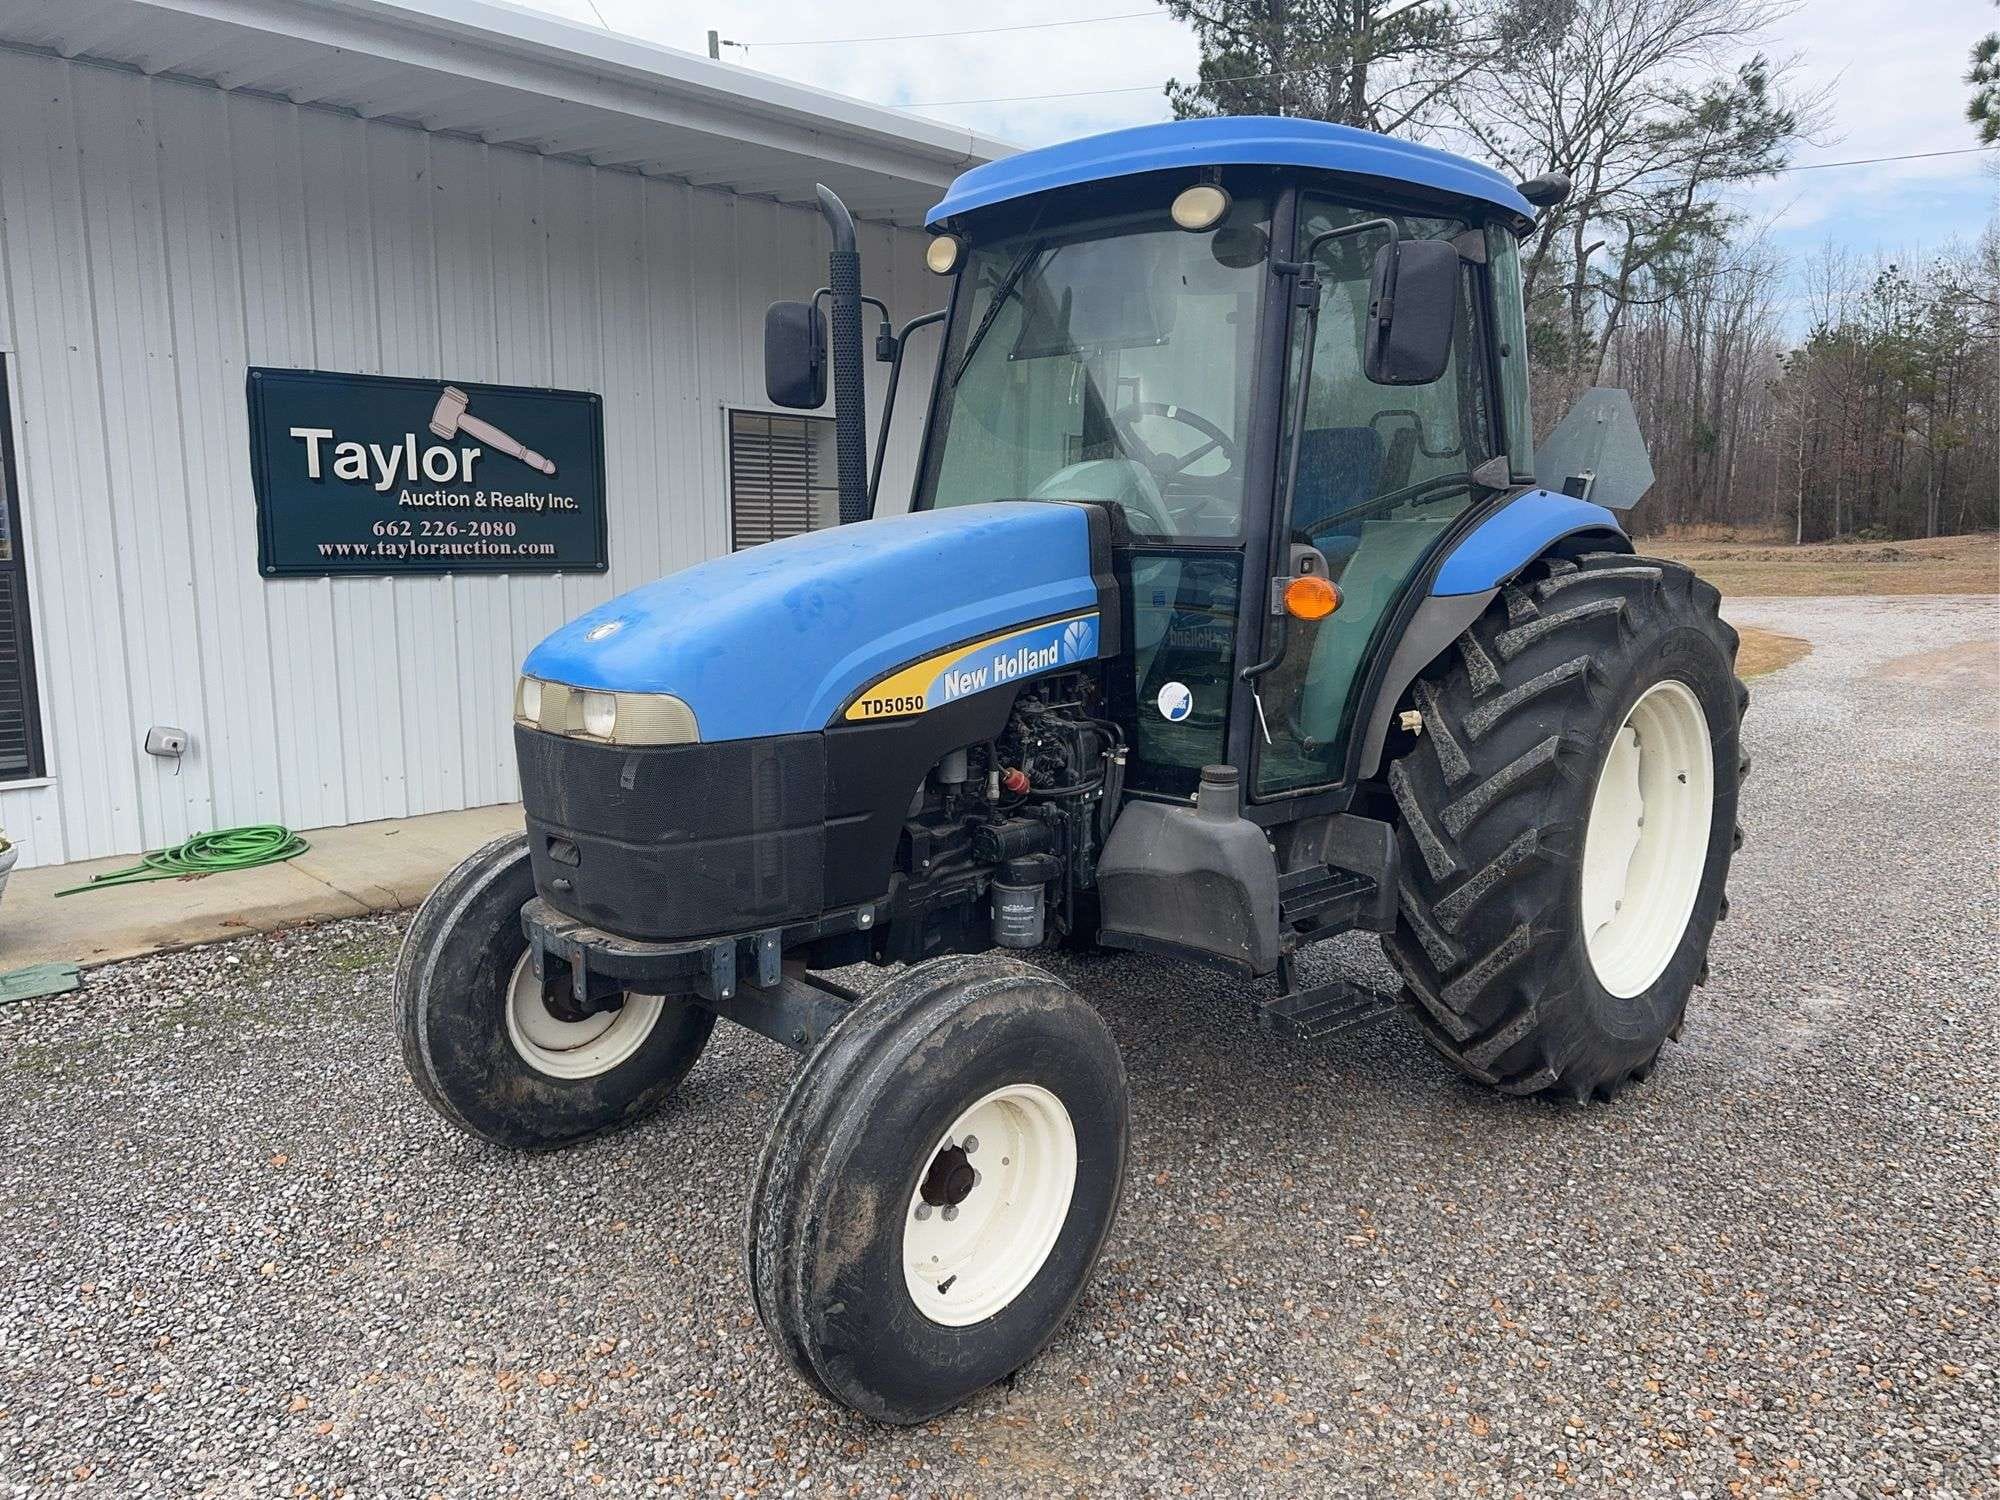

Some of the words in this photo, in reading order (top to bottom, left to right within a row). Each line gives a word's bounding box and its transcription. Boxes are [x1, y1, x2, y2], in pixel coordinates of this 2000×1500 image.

[290, 427, 481, 491] Taylor
[398, 489, 470, 507] Auction
[474, 491, 487, 507] &
[491, 492, 544, 511] Realty
[549, 493, 579, 509] Inc.
[372, 520, 412, 537] 662
[419, 521, 517, 537] 226-2080
[318, 539, 555, 559] www.taylorauction.com
[943, 667, 988, 700] New
[993, 640, 1058, 682] Holland
[861, 695, 924, 716] TD5050
